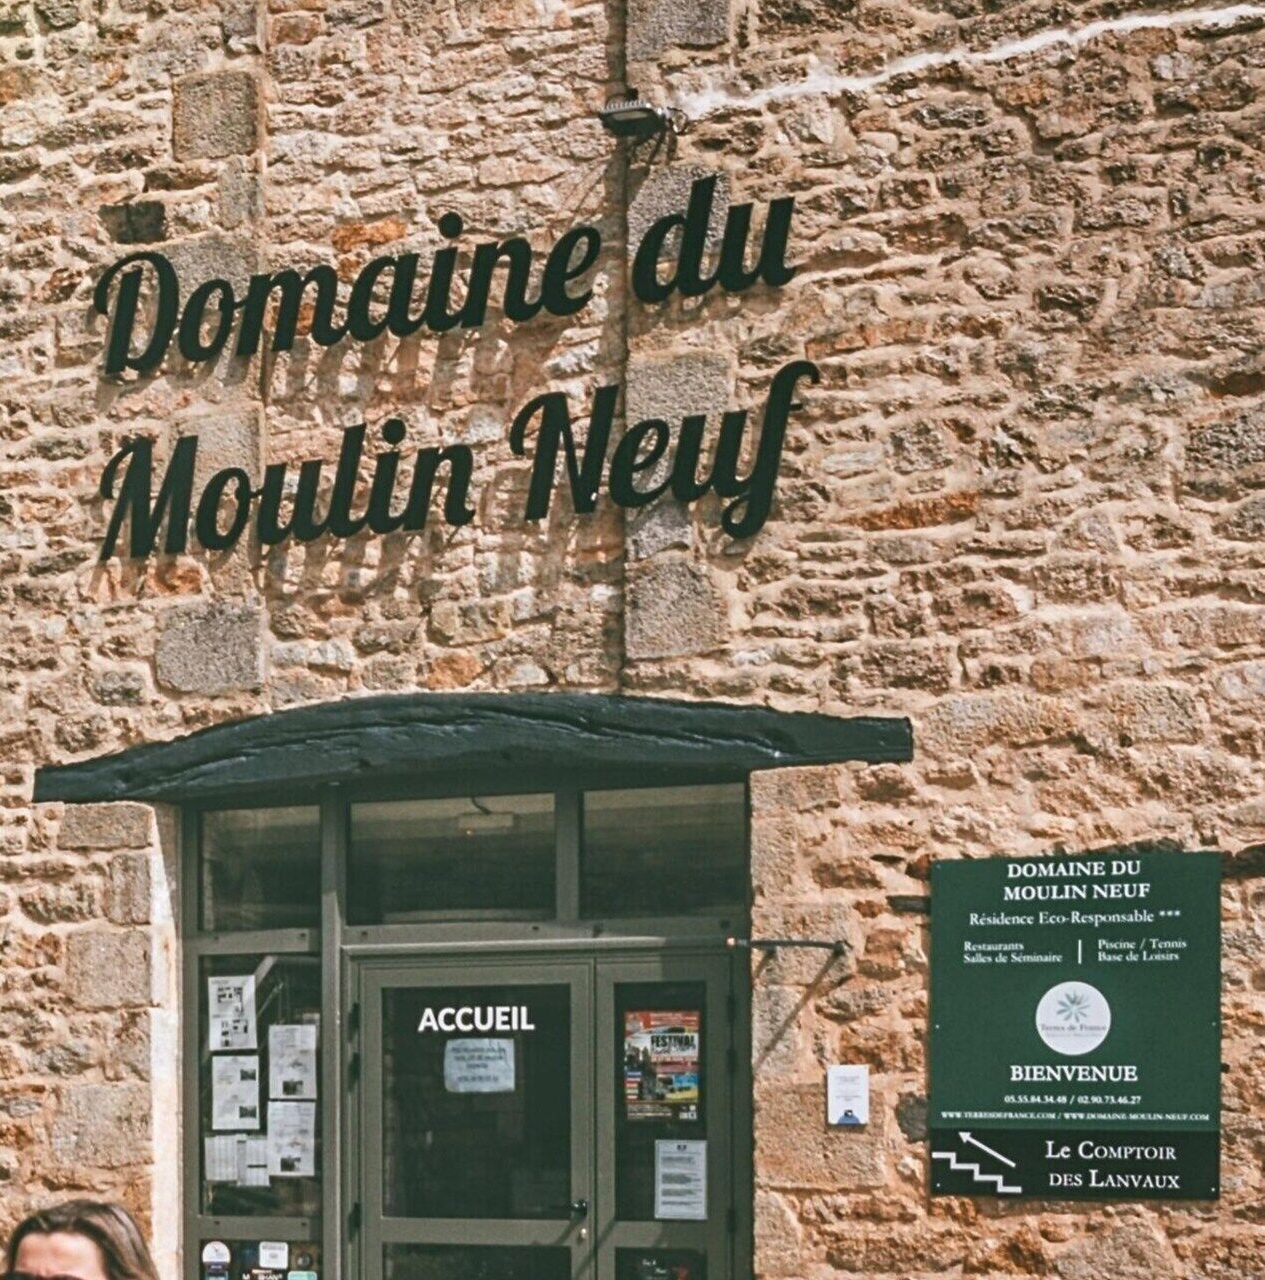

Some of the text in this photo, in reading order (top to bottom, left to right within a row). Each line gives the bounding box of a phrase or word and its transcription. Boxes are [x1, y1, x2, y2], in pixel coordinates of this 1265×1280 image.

[93, 174, 797, 375] Domaine du
[99, 360, 821, 561] Moulin Neuf
[1007, 860, 1141, 878] DOMAINE DU
[1003, 883, 1151, 900] MOULIN NEUF
[969, 909, 1154, 927] Résidence Eco-Responsable
[964, 941, 1024, 951] Restaurants
[1097, 939, 1136, 949] Piscine
[1149, 938, 1187, 948] Tennis
[964, 952, 1063, 963] Salles de Séminaire
[1097, 950, 1179, 961] Base de Loisirs
[417, 1006, 535, 1031] ACCUEIL
[1010, 1065, 1138, 1082] BIENVENUE
[1045, 1140, 1176, 1160] Le COMPTOIR
[1049, 1169, 1180, 1189] DES LANVAUX
